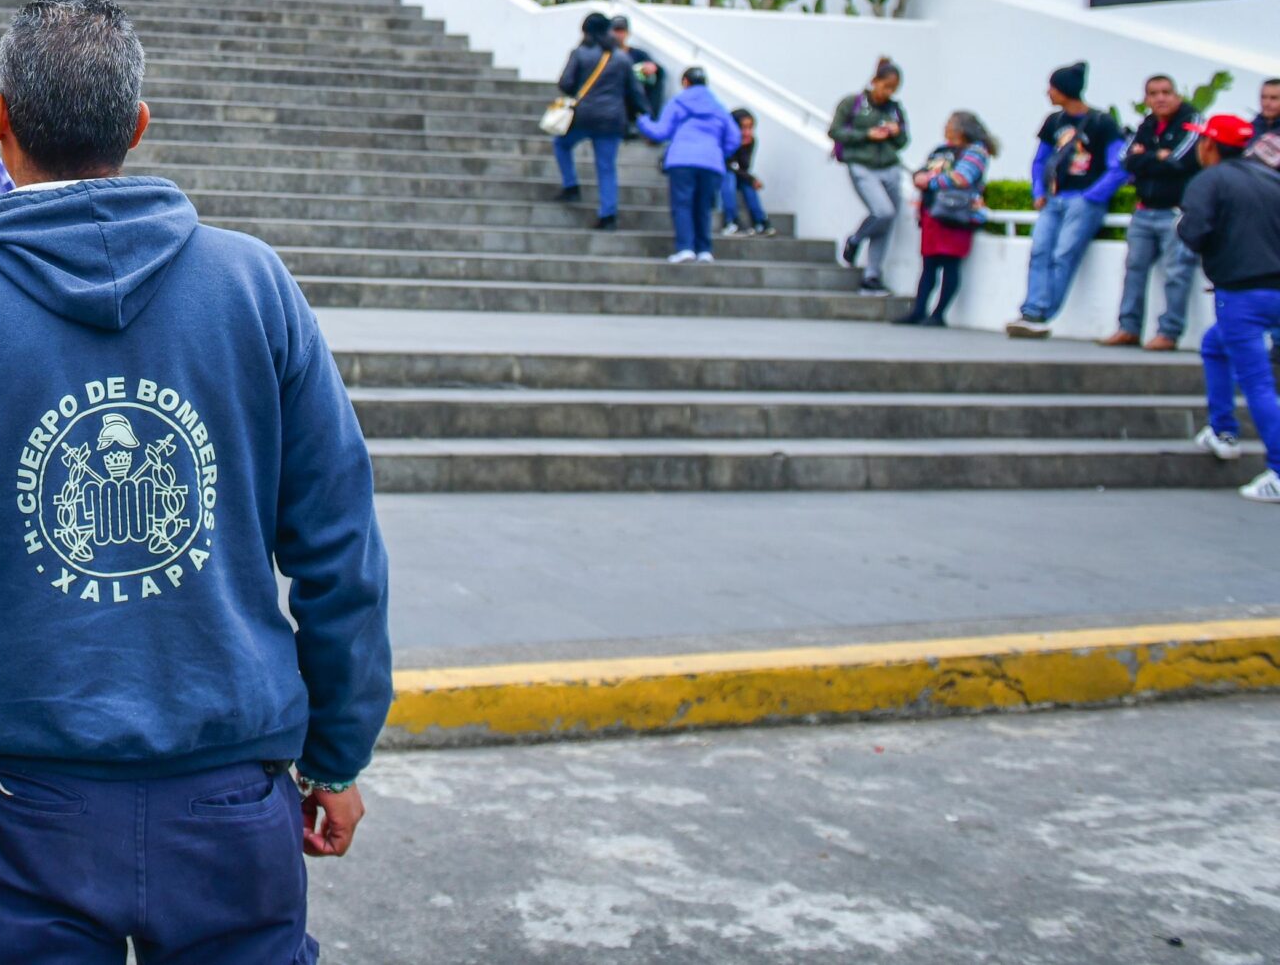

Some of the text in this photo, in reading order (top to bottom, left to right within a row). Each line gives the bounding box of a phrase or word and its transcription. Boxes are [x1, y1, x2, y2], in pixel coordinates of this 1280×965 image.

[17, 394, 78, 514] CUERPO
[85, 377, 126, 404] DE
[136, 378, 218, 531] BOMBEROS
[51, 547, 210, 602] XALAPA
